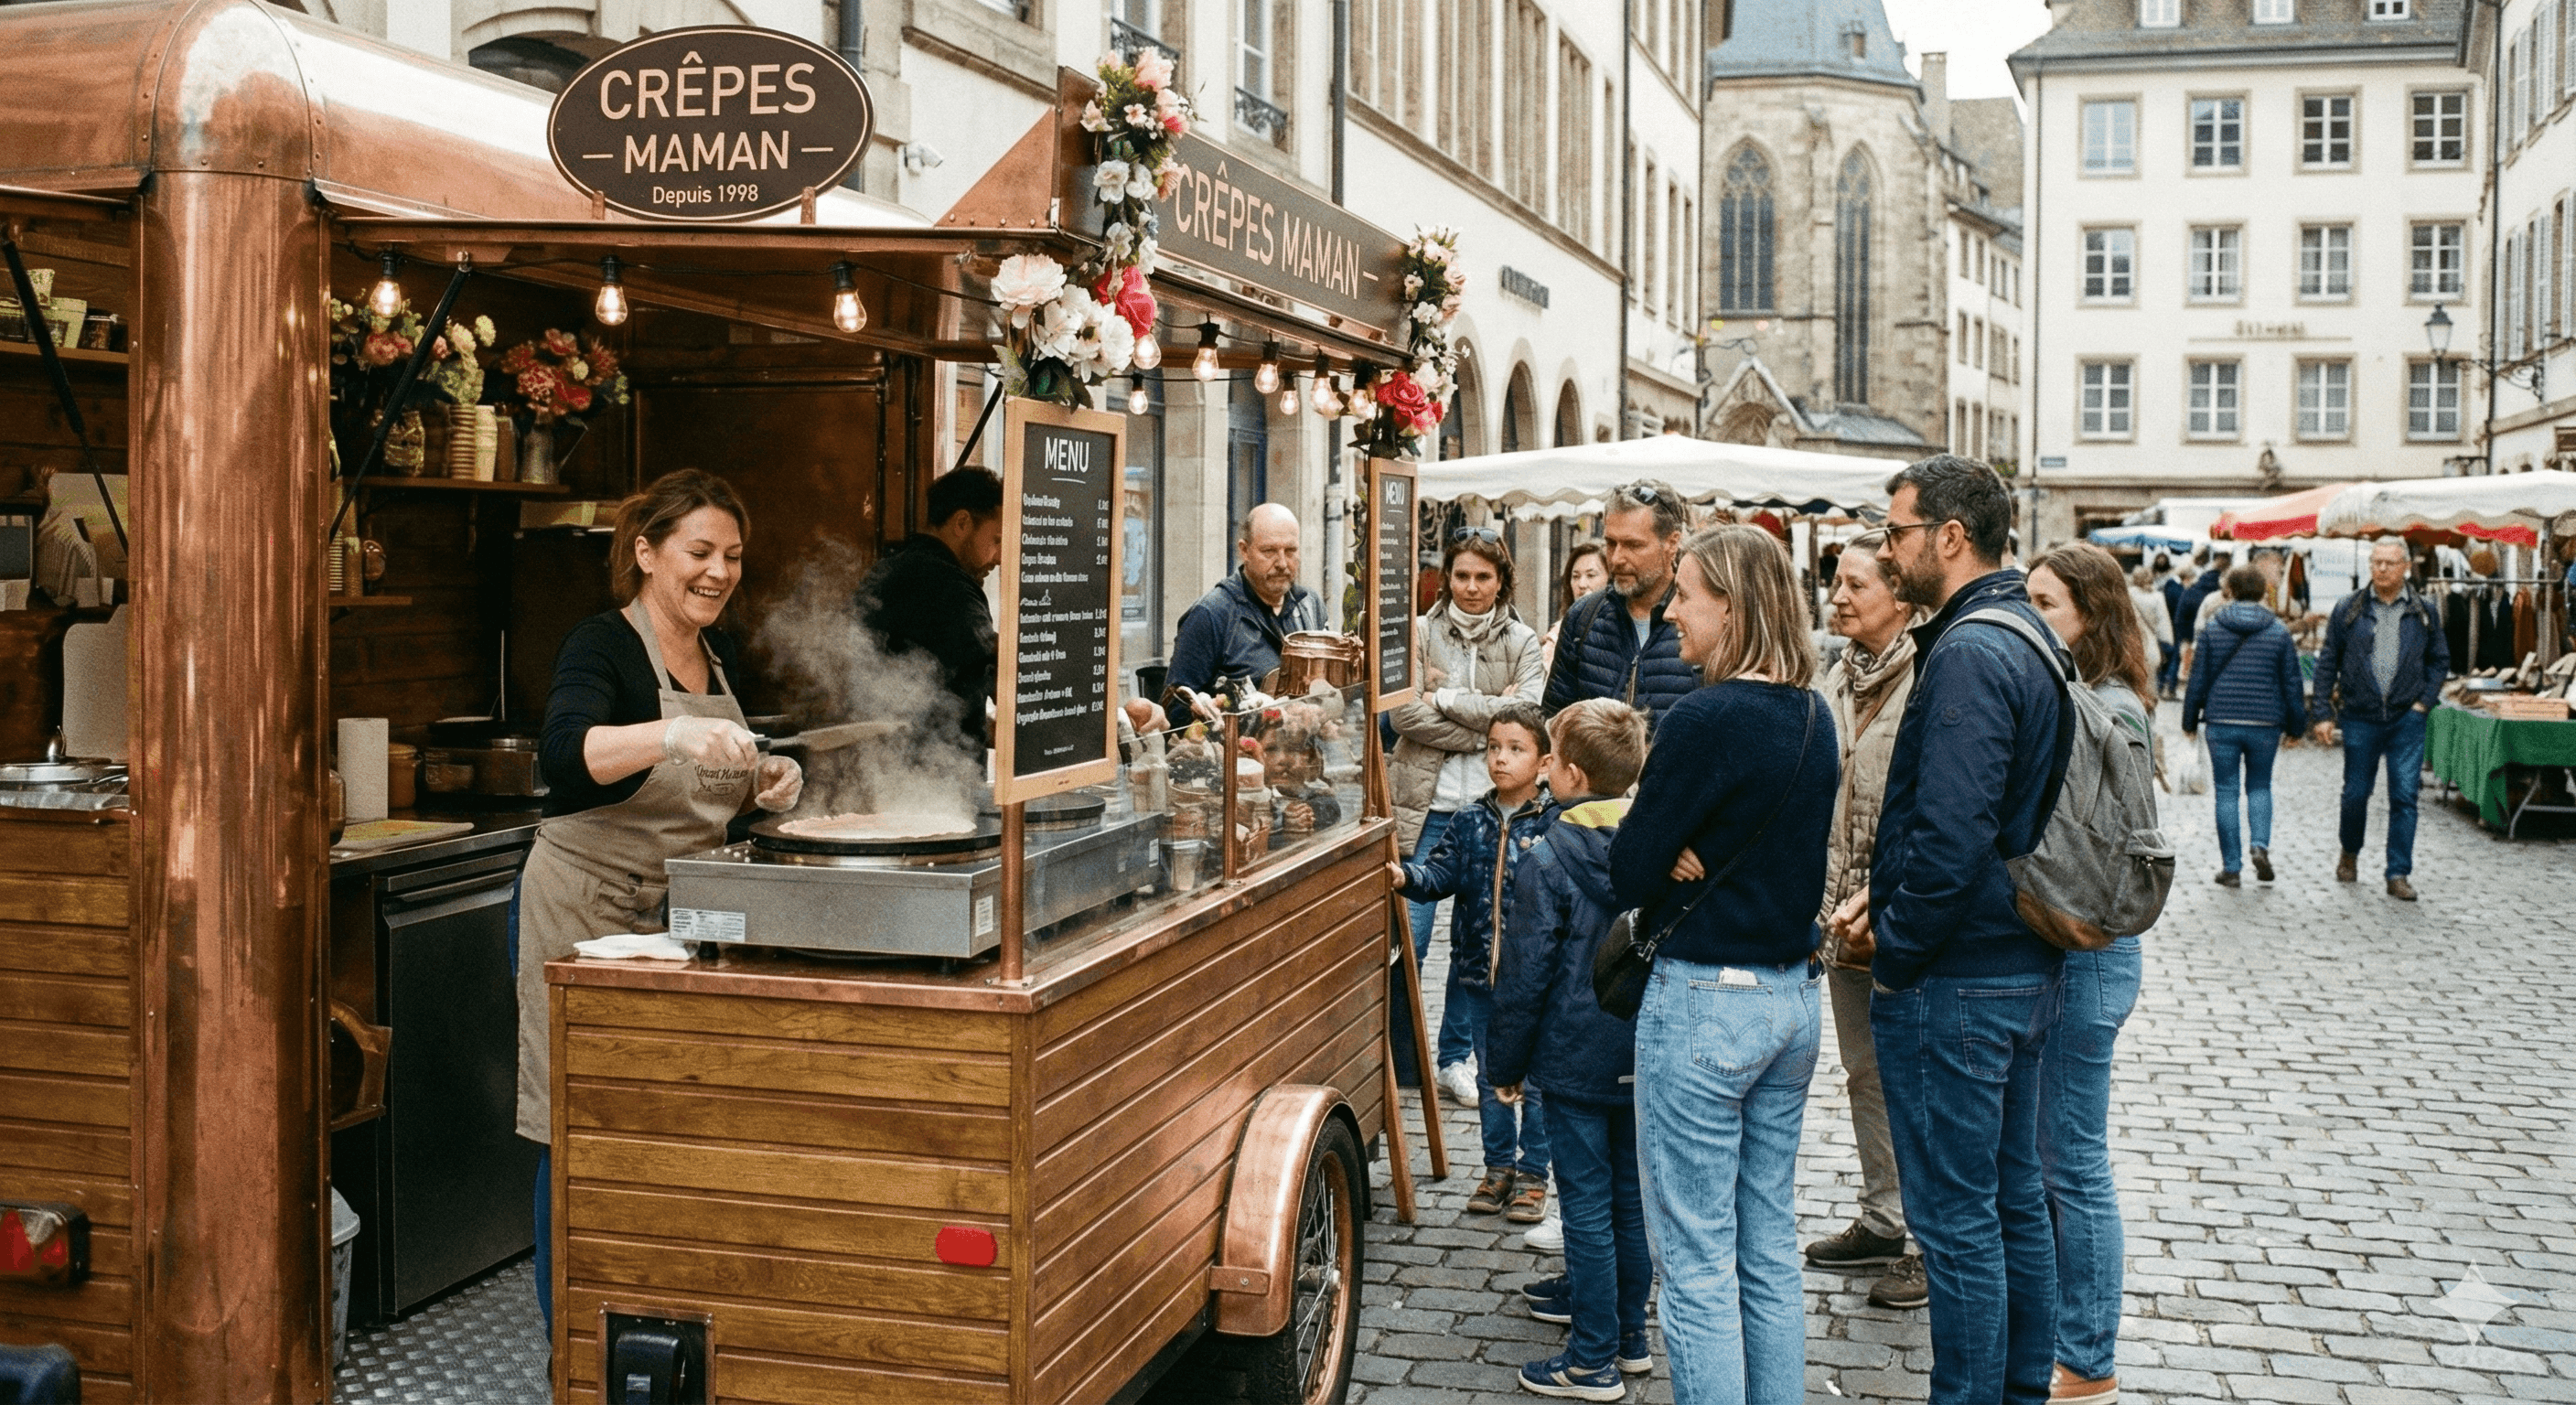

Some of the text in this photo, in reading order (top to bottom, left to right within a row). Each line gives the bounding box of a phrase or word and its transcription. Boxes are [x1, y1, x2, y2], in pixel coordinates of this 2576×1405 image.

[600, 50, 816, 120] CRÊPES
[625, 130, 789, 174] MAMAN
[652, 184, 758, 208] Depuis 1998
[1175, 160, 1359, 299] CRÊPES MAMAN
[1045, 436, 1089, 473] MENU
